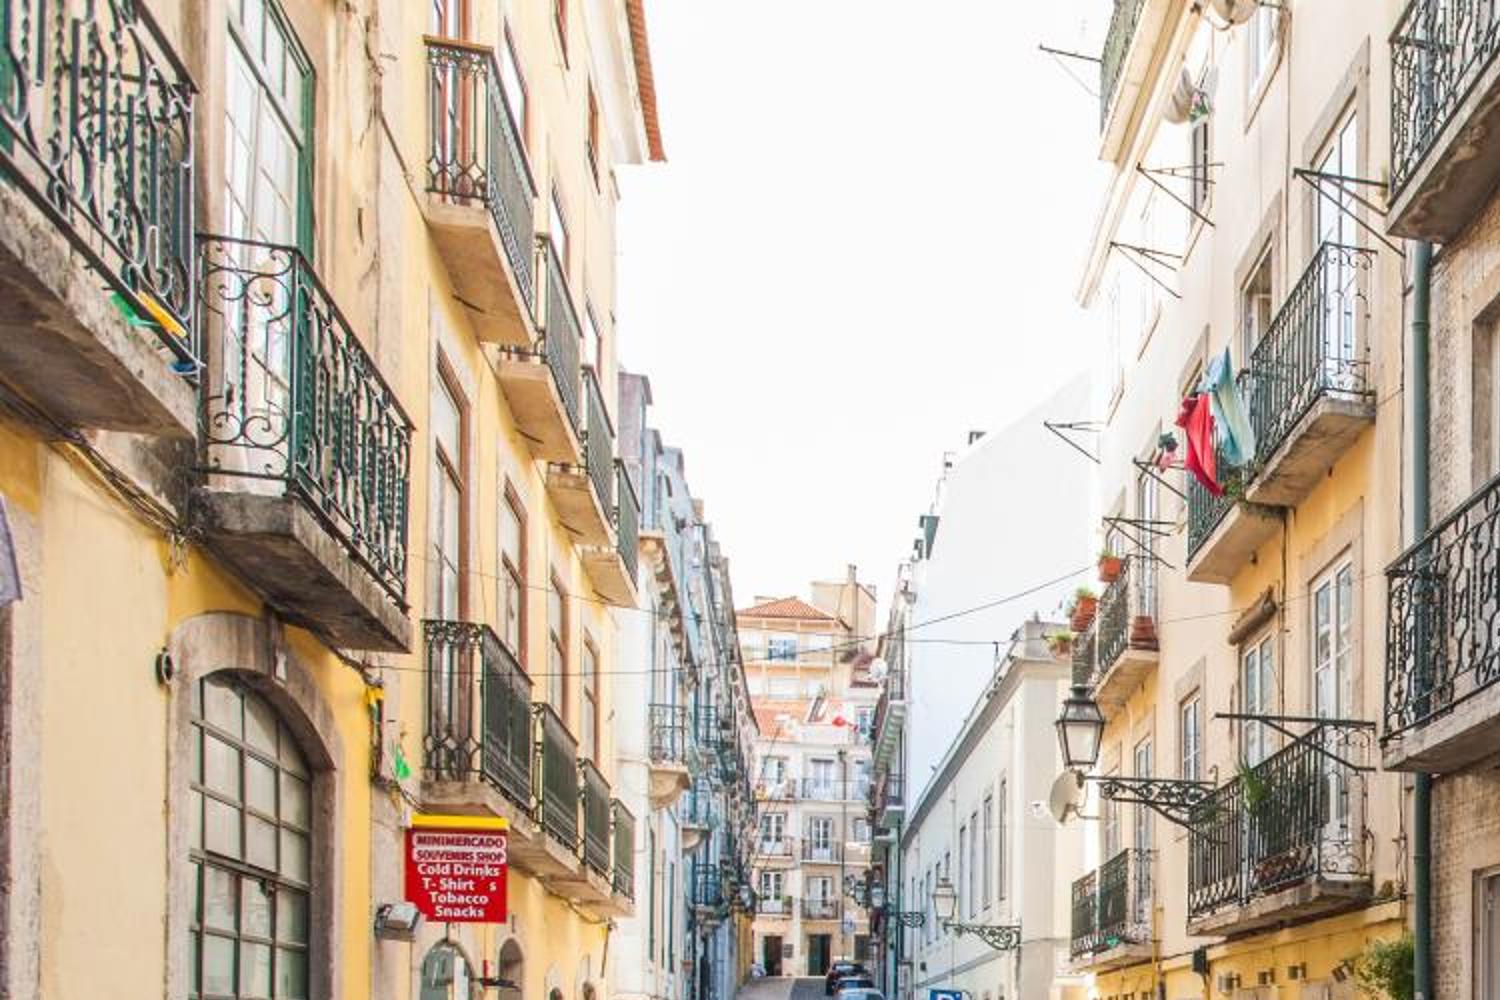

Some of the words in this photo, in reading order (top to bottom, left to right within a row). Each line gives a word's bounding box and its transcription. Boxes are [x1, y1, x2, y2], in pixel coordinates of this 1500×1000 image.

[416, 836, 504, 847] MINIMERCADO
[477, 852, 504, 863] SHOP
[417, 863, 451, 876] Cold
[454, 864, 500, 878] Drinks
[430, 891, 489, 904] Tobacco
[436, 905, 485, 917] Snacks
